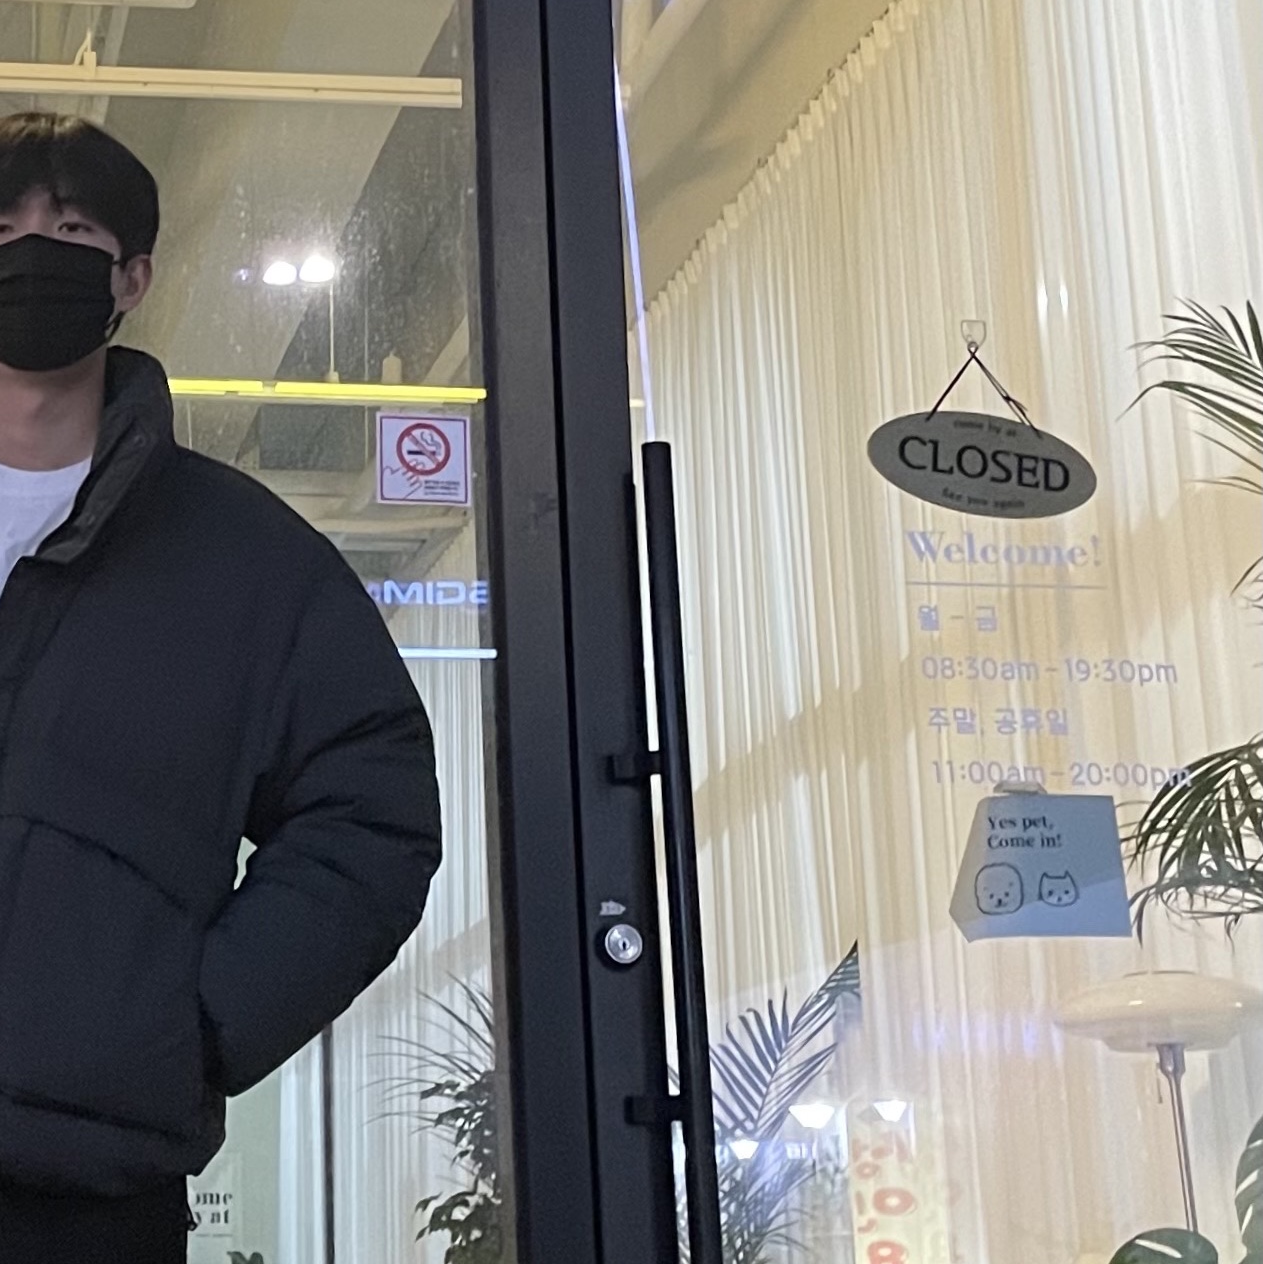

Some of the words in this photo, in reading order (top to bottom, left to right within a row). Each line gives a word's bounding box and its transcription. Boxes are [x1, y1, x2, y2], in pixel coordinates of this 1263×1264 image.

[899, 436, 1071, 492] CLOSED
[907, 530, 1101, 567] Welcome!
[919, 605, 940, 631] 월
[975, 605, 998, 632] 금
[987, 815, 1017, 831] Yes
[987, 834, 1033, 850] Come
[1039, 834, 1063, 849] in!
